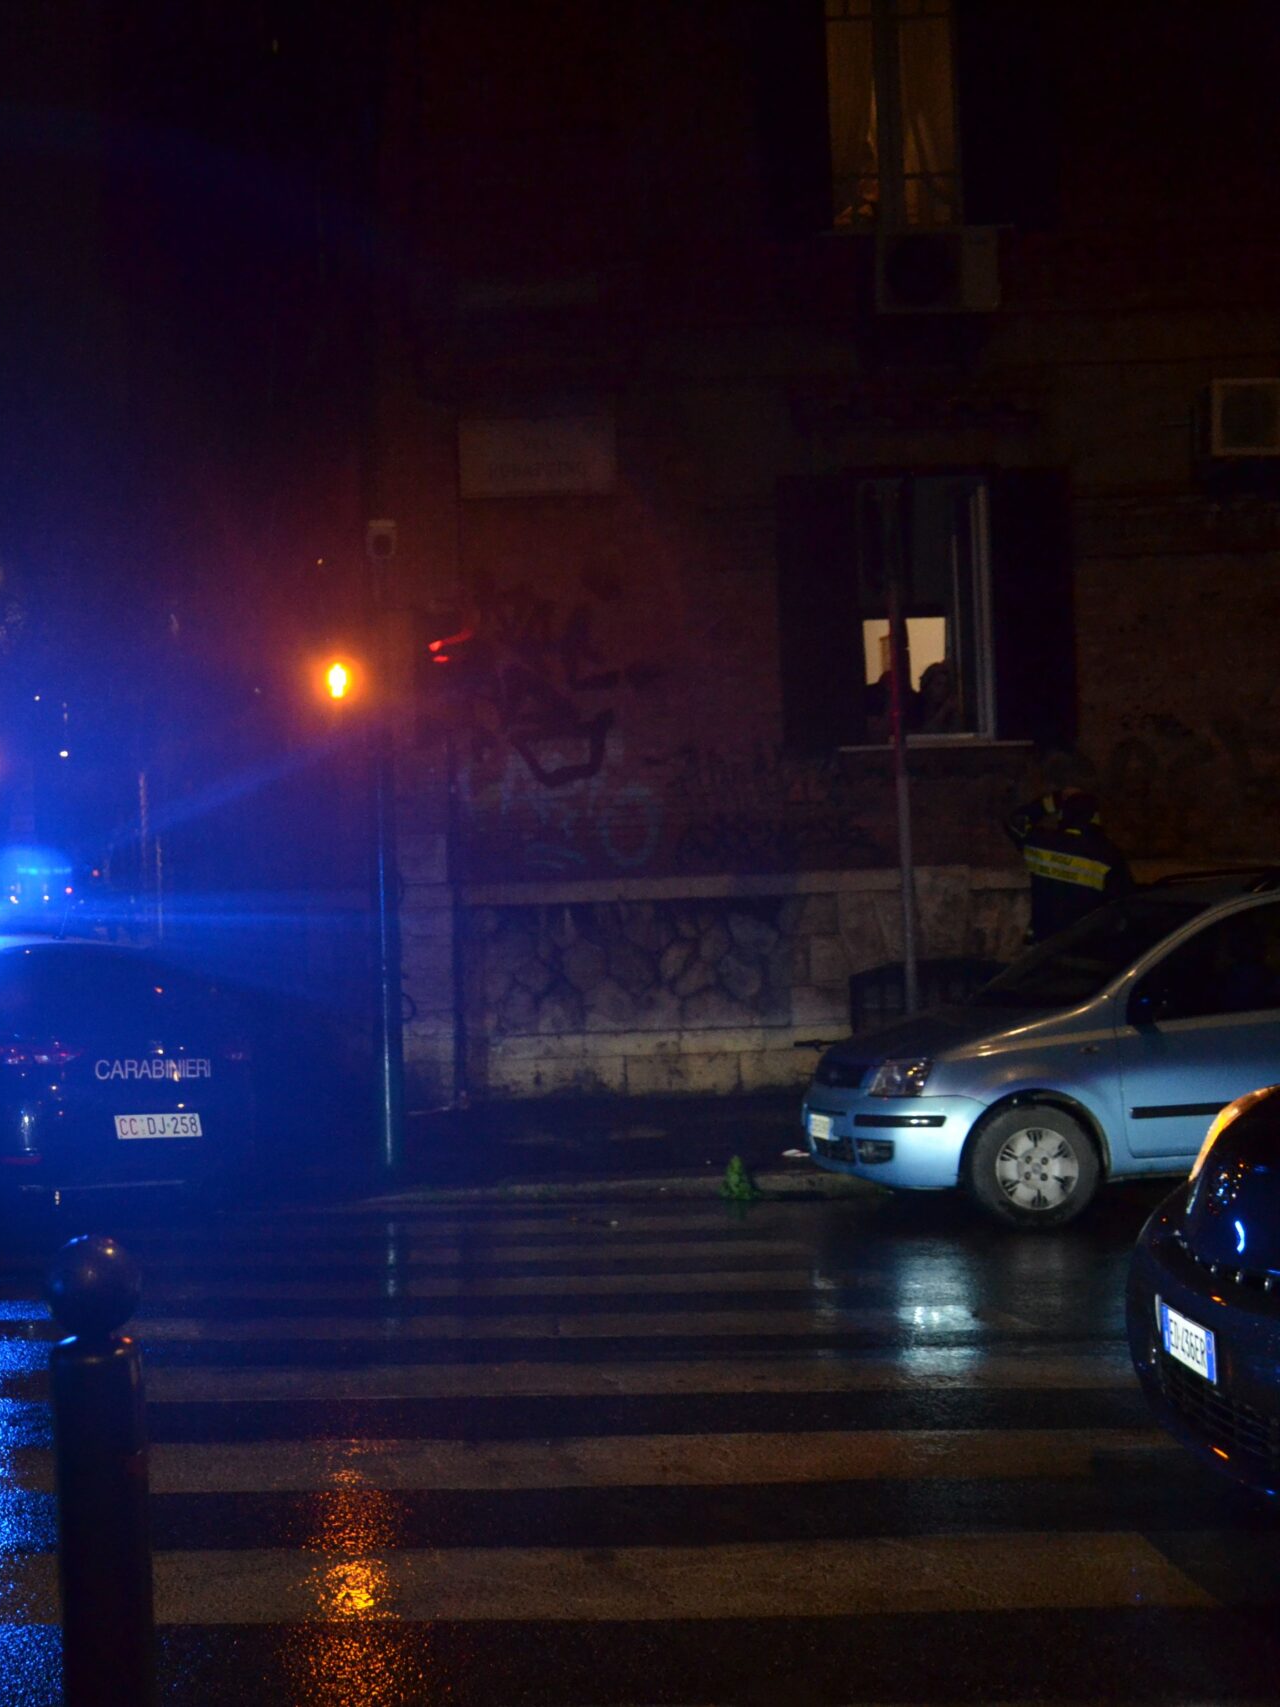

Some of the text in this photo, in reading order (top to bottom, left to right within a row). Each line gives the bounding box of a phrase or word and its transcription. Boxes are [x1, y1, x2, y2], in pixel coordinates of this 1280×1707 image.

[95, 1059, 211, 1080] CARABINIERI
[119, 1118, 139, 1136] CC
[170, 1116, 199, 1135] 258
